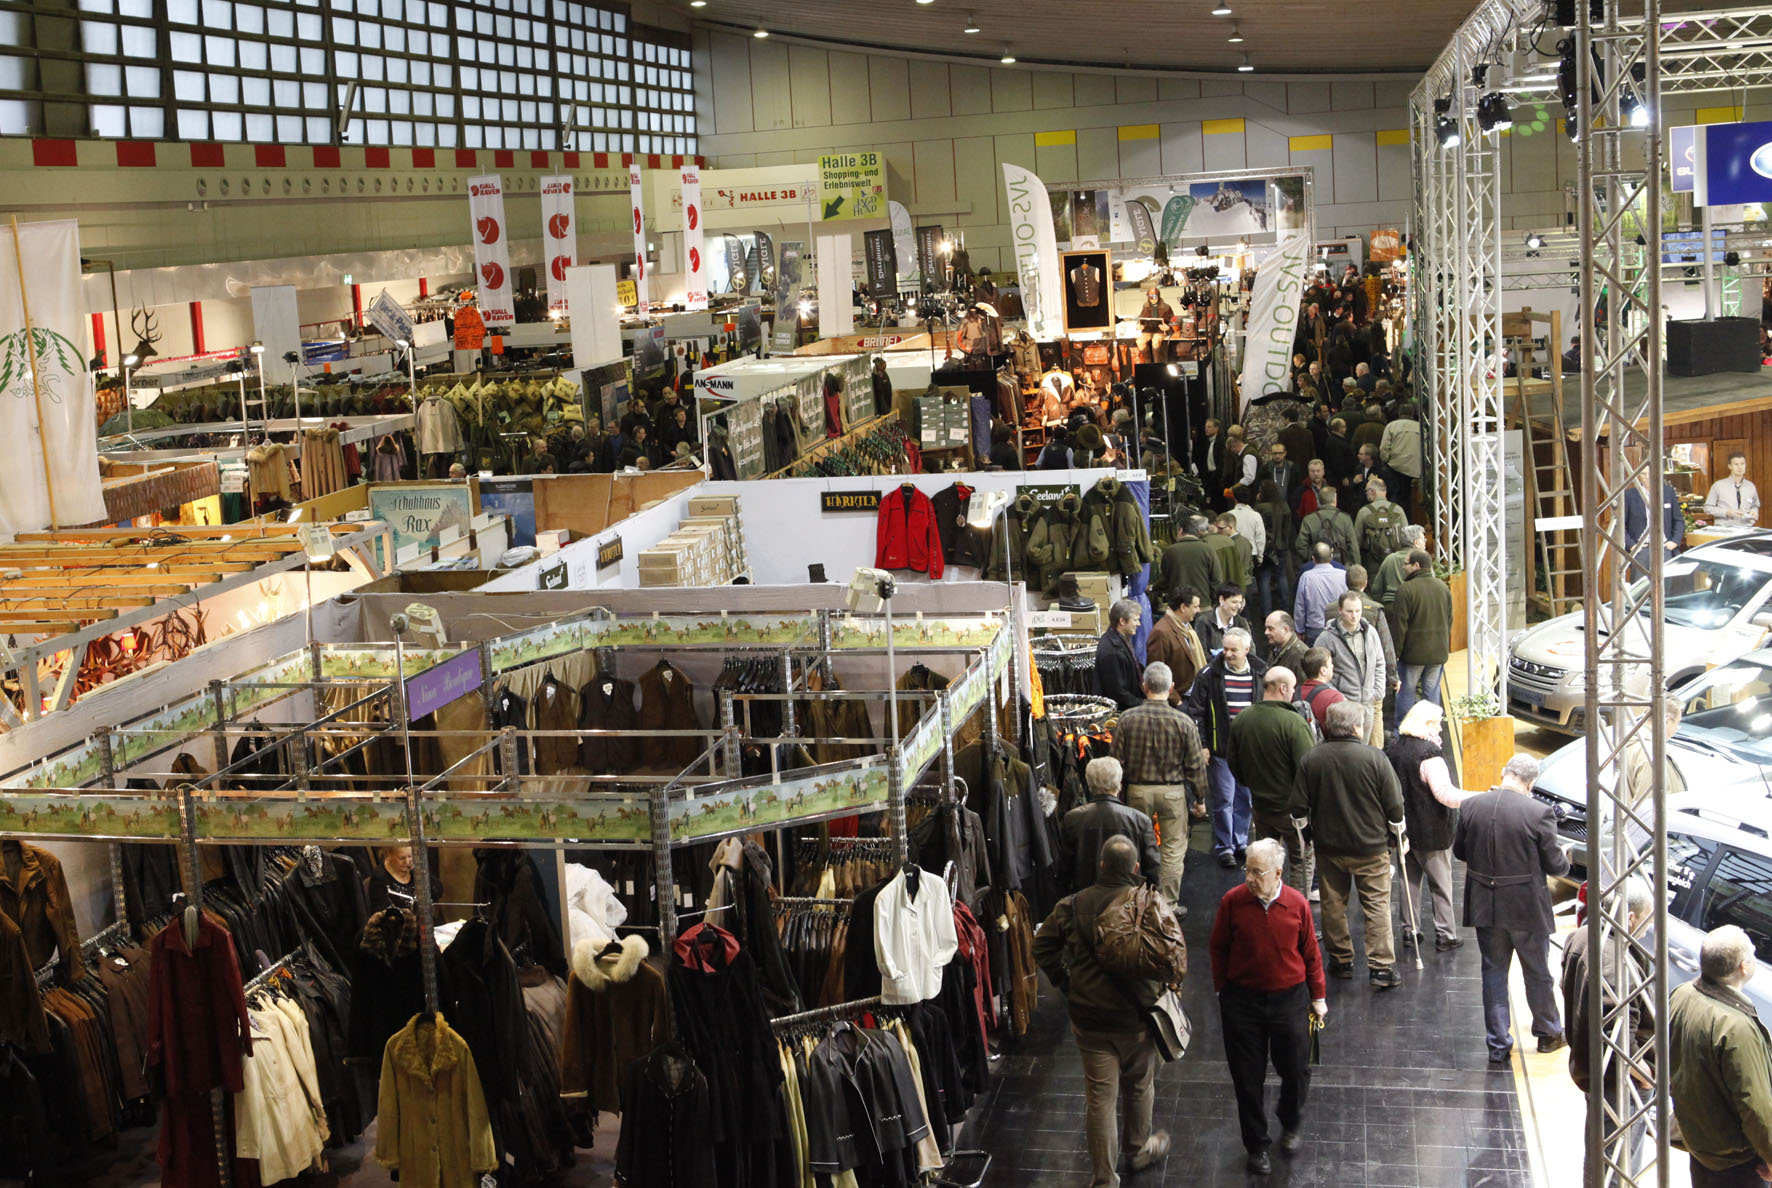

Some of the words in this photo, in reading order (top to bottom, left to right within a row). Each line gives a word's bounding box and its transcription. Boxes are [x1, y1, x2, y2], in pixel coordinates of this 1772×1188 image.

[822, 156, 856, 169] Halle
[860, 153, 877, 167] 3B
[823, 170, 863, 180] Shopping-
[864, 168, 879, 177] und
[824, 179, 871, 190] Erlebniswelt
[740, 191, 777, 202] HALLE
[780, 189, 797, 200] 3B
[695, 379, 733, 390] ANSMANN
[1029, 486, 1068, 501] Seeland
[404, 514, 433, 533] Rax
